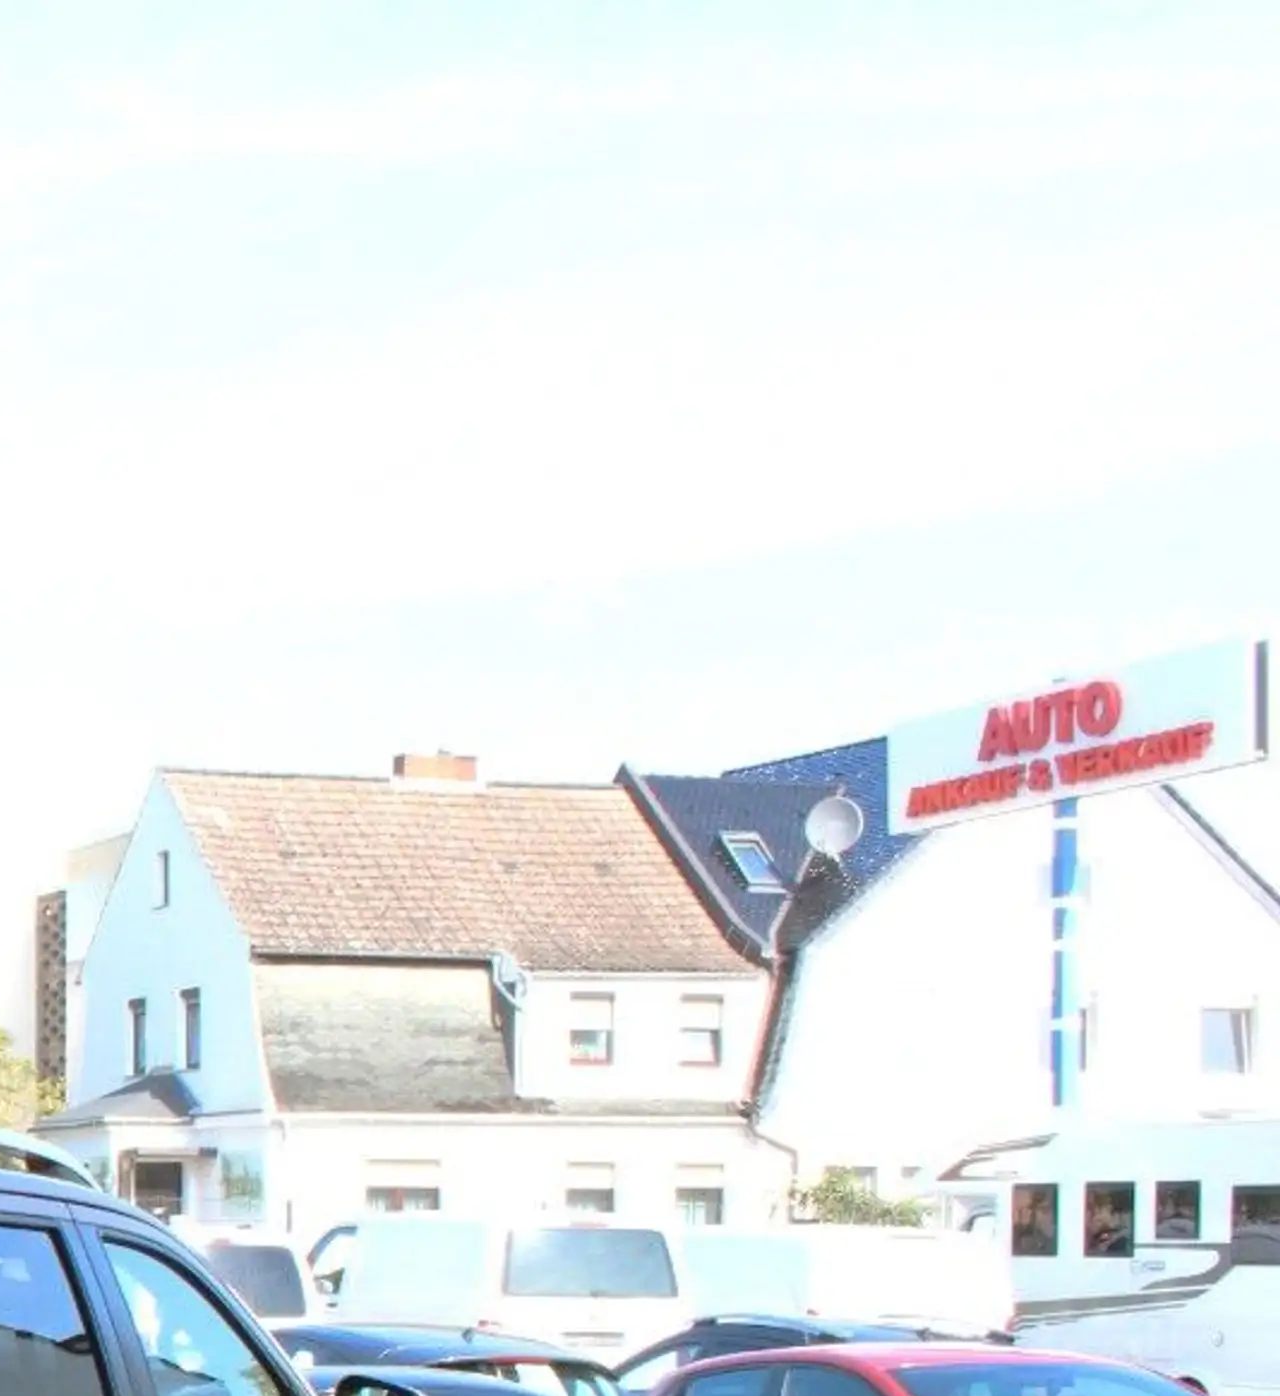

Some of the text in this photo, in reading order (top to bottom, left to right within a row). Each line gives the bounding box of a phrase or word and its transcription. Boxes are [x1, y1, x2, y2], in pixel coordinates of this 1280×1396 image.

[978, 681, 1123, 761] AUTO
[906, 722, 1214, 818] ANKAUF & VERKAUF
